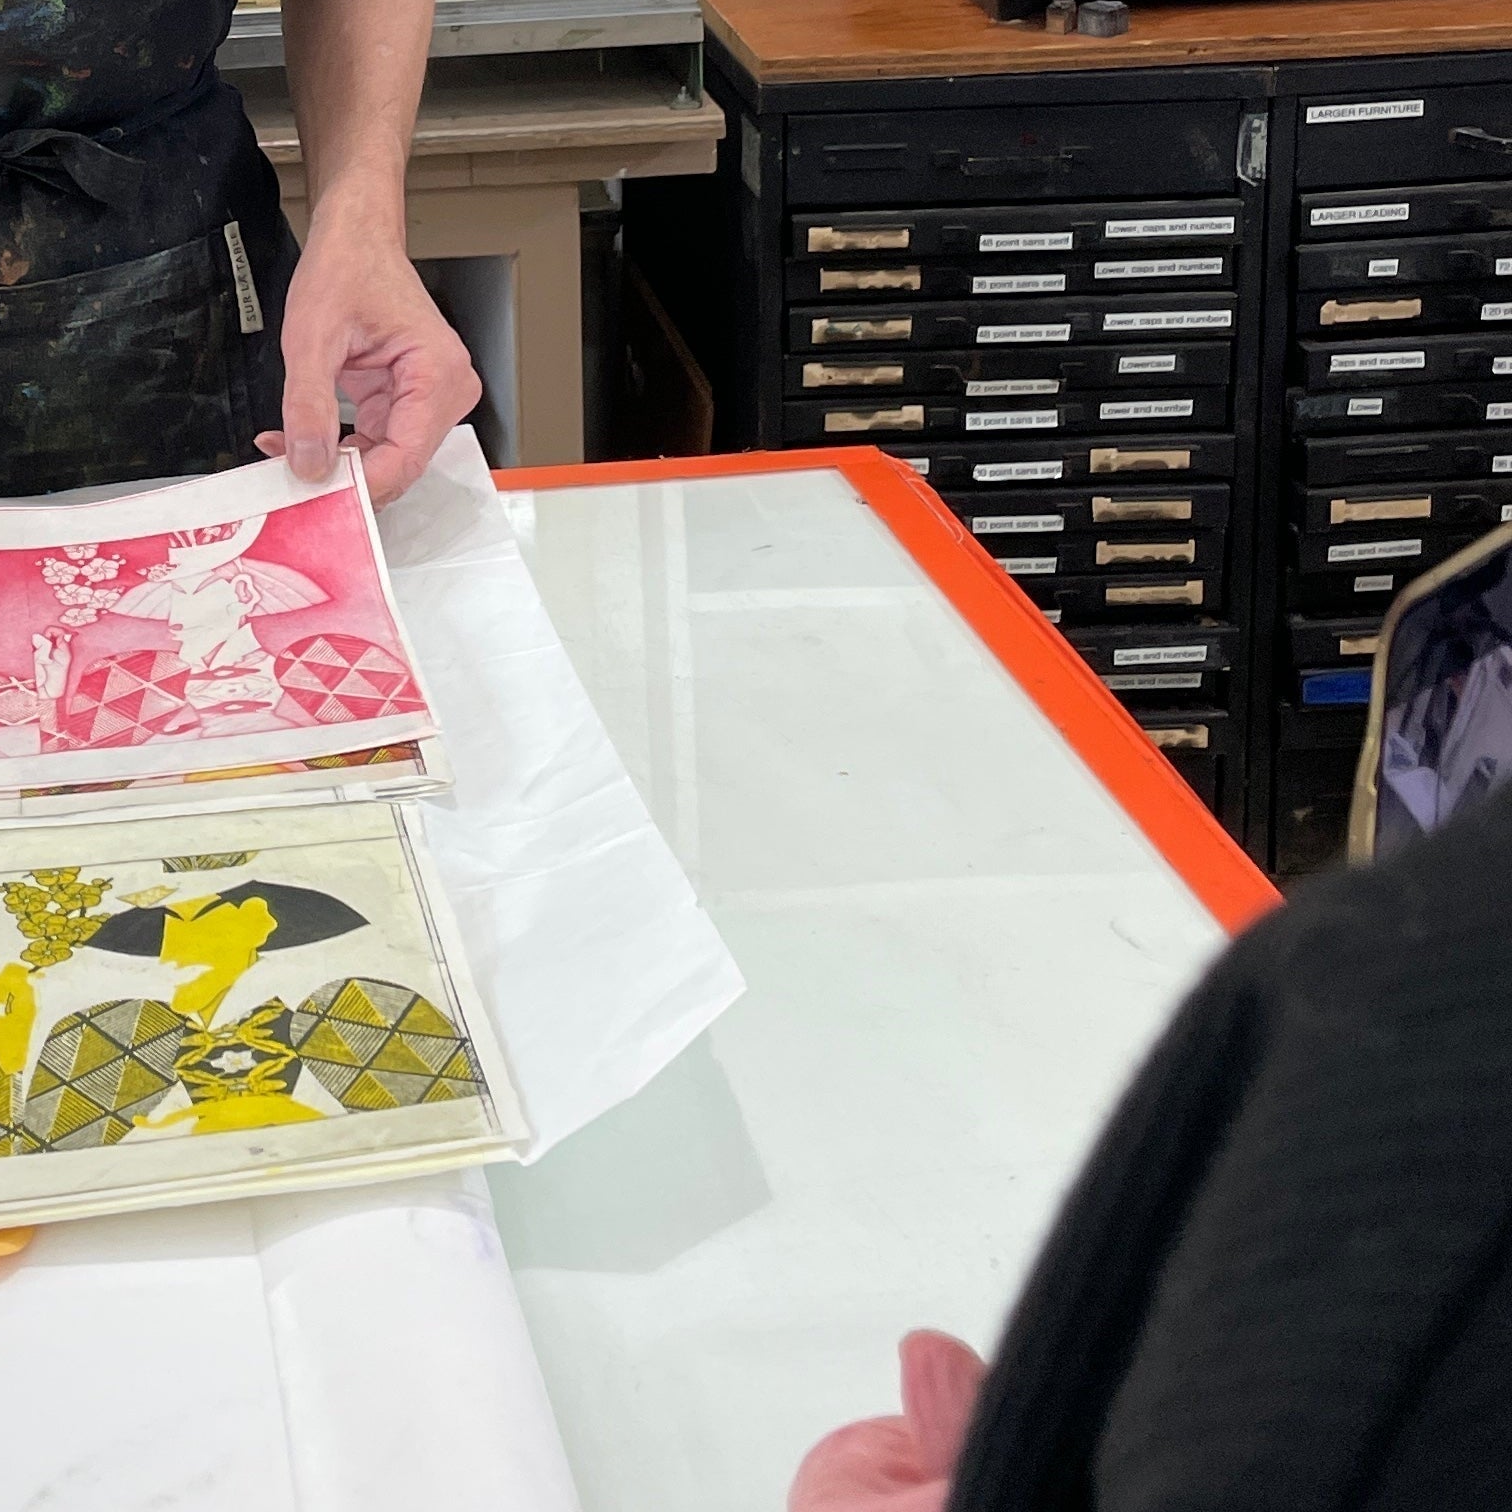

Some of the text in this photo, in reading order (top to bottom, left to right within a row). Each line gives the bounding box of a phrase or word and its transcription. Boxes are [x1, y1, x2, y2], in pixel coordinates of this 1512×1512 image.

[1311, 103, 1421, 119] LARGER FURNITURE
[1312, 207, 1407, 222] LARGER LEADING
[1142, 224, 1165, 233] caps
[1168, 222, 1187, 231] and
[1189, 221, 1232, 231] numbers
[995, 238, 1020, 248] point
[1131, 265, 1155, 275] caps
[1157, 263, 1176, 272] and
[1178, 261, 1221, 272] numbers
[231, 232, 257, 322] SUR LA TABLE
[990, 280, 1013, 290] point
[1016, 280, 1039, 288] sans
[1139, 316, 1162, 326] caps
[1165, 315, 1185, 324] and
[1186, 314, 1229, 324] numbers
[993, 329, 1017, 339] point
[1019, 329, 1043, 338] sans
[1121, 359, 1173, 370] Lowercase
[1331, 356, 1423, 367] Caps and numbers
[984, 383, 1008, 393] point
[1010, 384, 1034, 392] sans
[1102, 403, 1191, 415] Lower and number
[1350, 403, 1381, 412] Lower
[983, 416, 1008, 427] point
[1009, 416, 1033, 424] sans
[989, 467, 1014, 478] point
[1015, 467, 1039, 475] sans
[989, 520, 1014, 530] point
[1016, 520, 1039, 528] sans
[1330, 547, 1355, 558] Caps
[1357, 546, 1376, 556] and
[1009, 562, 1033, 570] sans
[1116, 649, 1204, 663] Caps and numbers
[1112, 676, 1199, 687] caps and numbers
